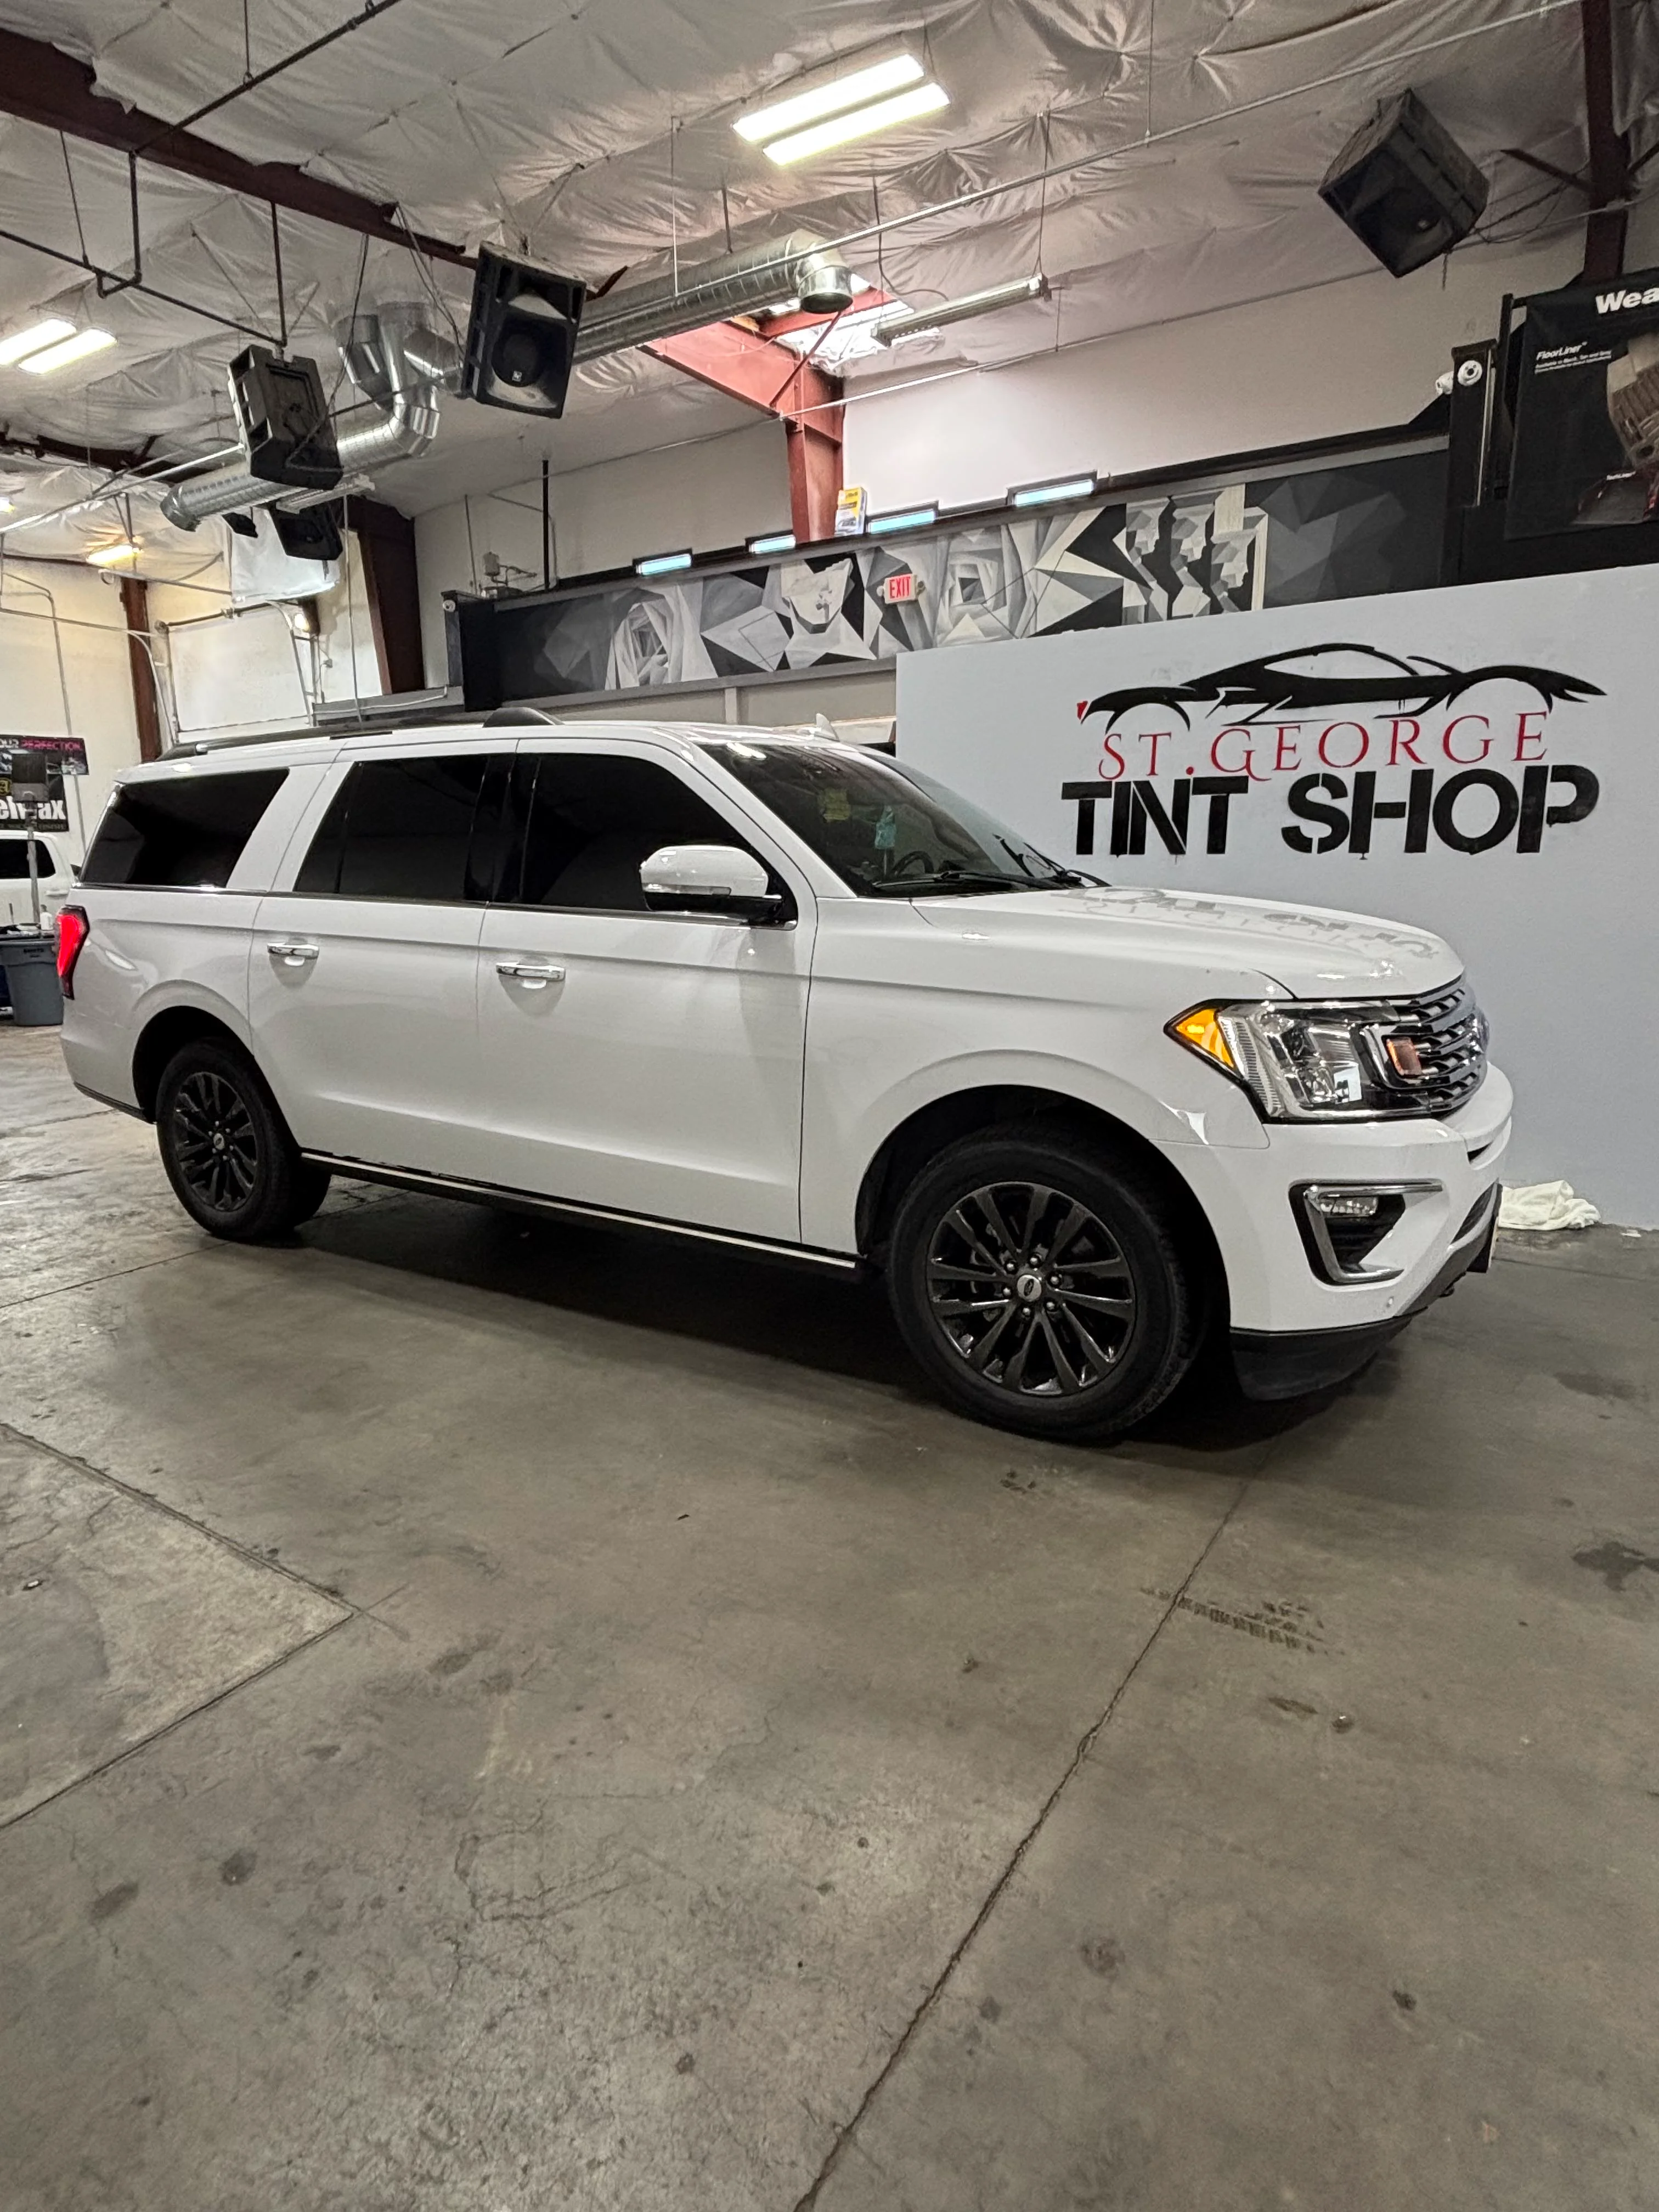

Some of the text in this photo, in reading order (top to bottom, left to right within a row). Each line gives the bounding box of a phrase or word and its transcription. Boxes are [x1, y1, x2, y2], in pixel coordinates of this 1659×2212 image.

[1595, 287, 1659, 314] Wea
[889, 576, 911, 599] EXIT
[1062, 765, 1600, 856] TINT SHOP
